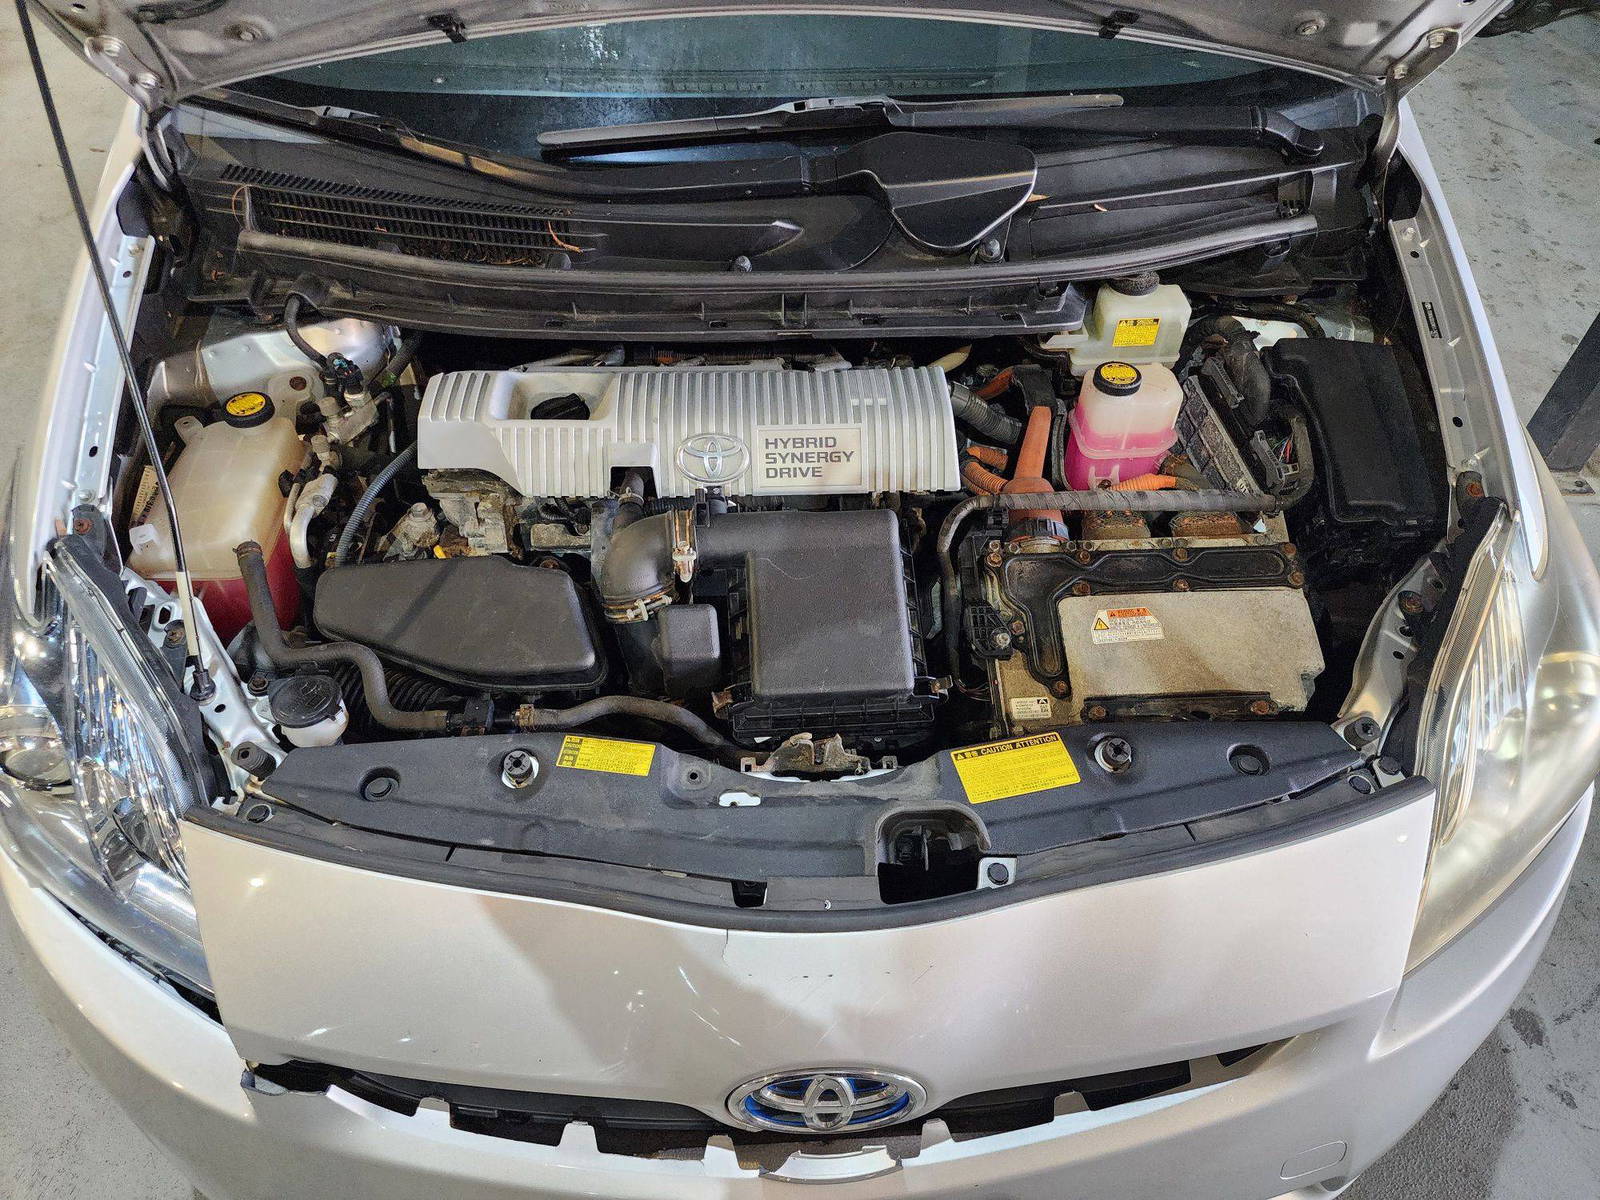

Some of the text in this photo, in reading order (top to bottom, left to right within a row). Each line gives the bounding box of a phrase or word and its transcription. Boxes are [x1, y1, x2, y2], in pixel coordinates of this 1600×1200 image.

[765, 437, 837, 449] HYBRID
[765, 451, 854, 464] SYNERGY
[766, 466, 823, 478] DRIVE
[980, 743, 1014, 755] CAUTION
[1015, 735, 1057, 749] ATTENTION
